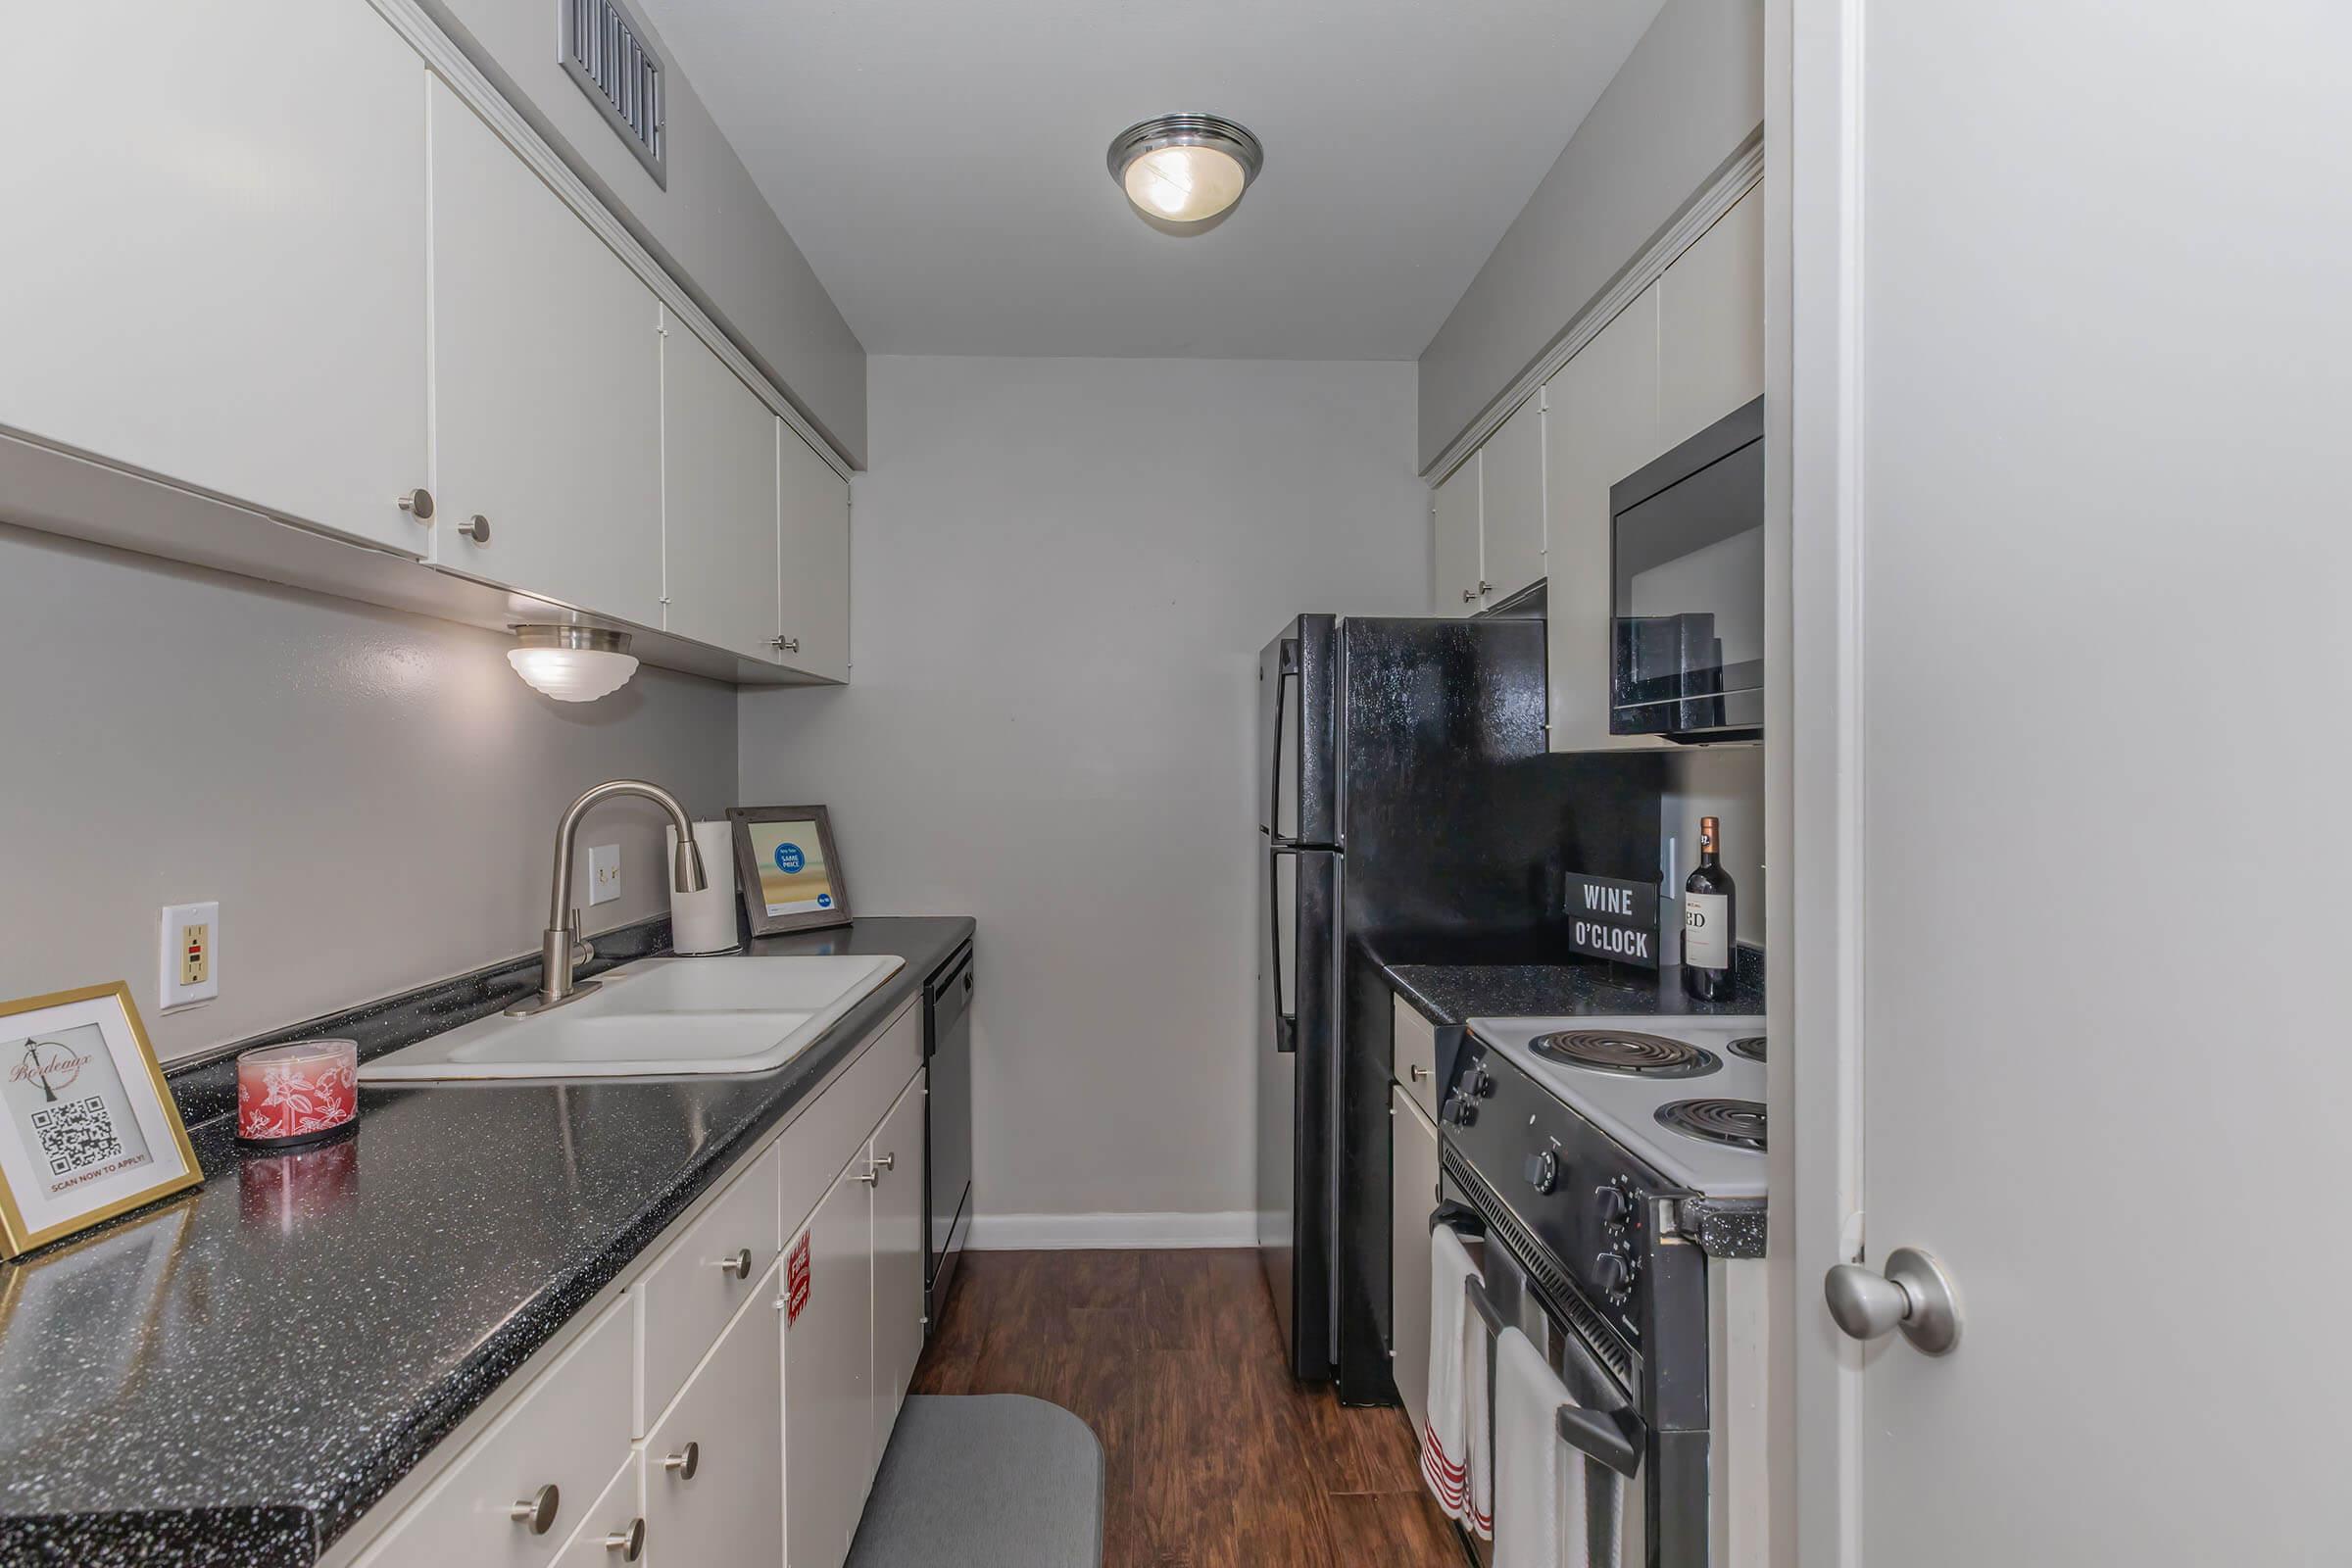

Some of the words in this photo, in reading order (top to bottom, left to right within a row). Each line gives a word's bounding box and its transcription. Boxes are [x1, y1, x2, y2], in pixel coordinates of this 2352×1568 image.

[1584, 884, 1633, 915] WINE
[1575, 921, 1647, 958] O'CLOCK
[9, 1054, 92, 1082] Bordeaux
[51, 1178, 78, 1193] SCAN
[79, 1169, 102, 1184] NOW
[104, 1163, 117, 1174] TO
